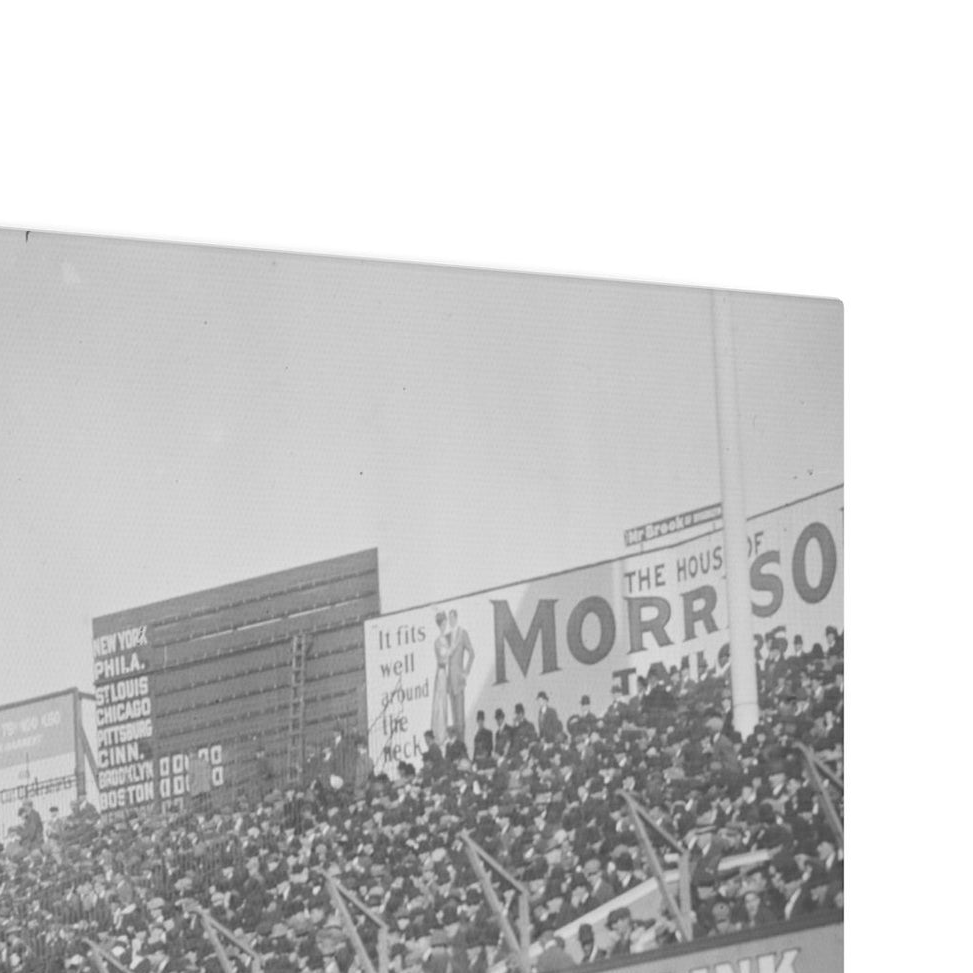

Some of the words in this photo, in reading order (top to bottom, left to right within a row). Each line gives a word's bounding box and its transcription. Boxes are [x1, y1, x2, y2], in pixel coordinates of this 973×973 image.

[624, 564, 665, 594] THE
[677, 546, 726, 583] HOUS
[490, 520, 844, 686] MORRSO
[397, 624, 426, 646] fits
[95, 652, 145, 680] PHILA.
[380, 652, 414, 677] well
[381, 677, 429, 708] around
[96, 697, 151, 726] CHICAGO
[382, 715, 408, 736] the
[98, 741, 144, 769] CINN.
[99, 761, 153, 790] BROOKLYN
[99, 780, 154, 811] BOSTON
